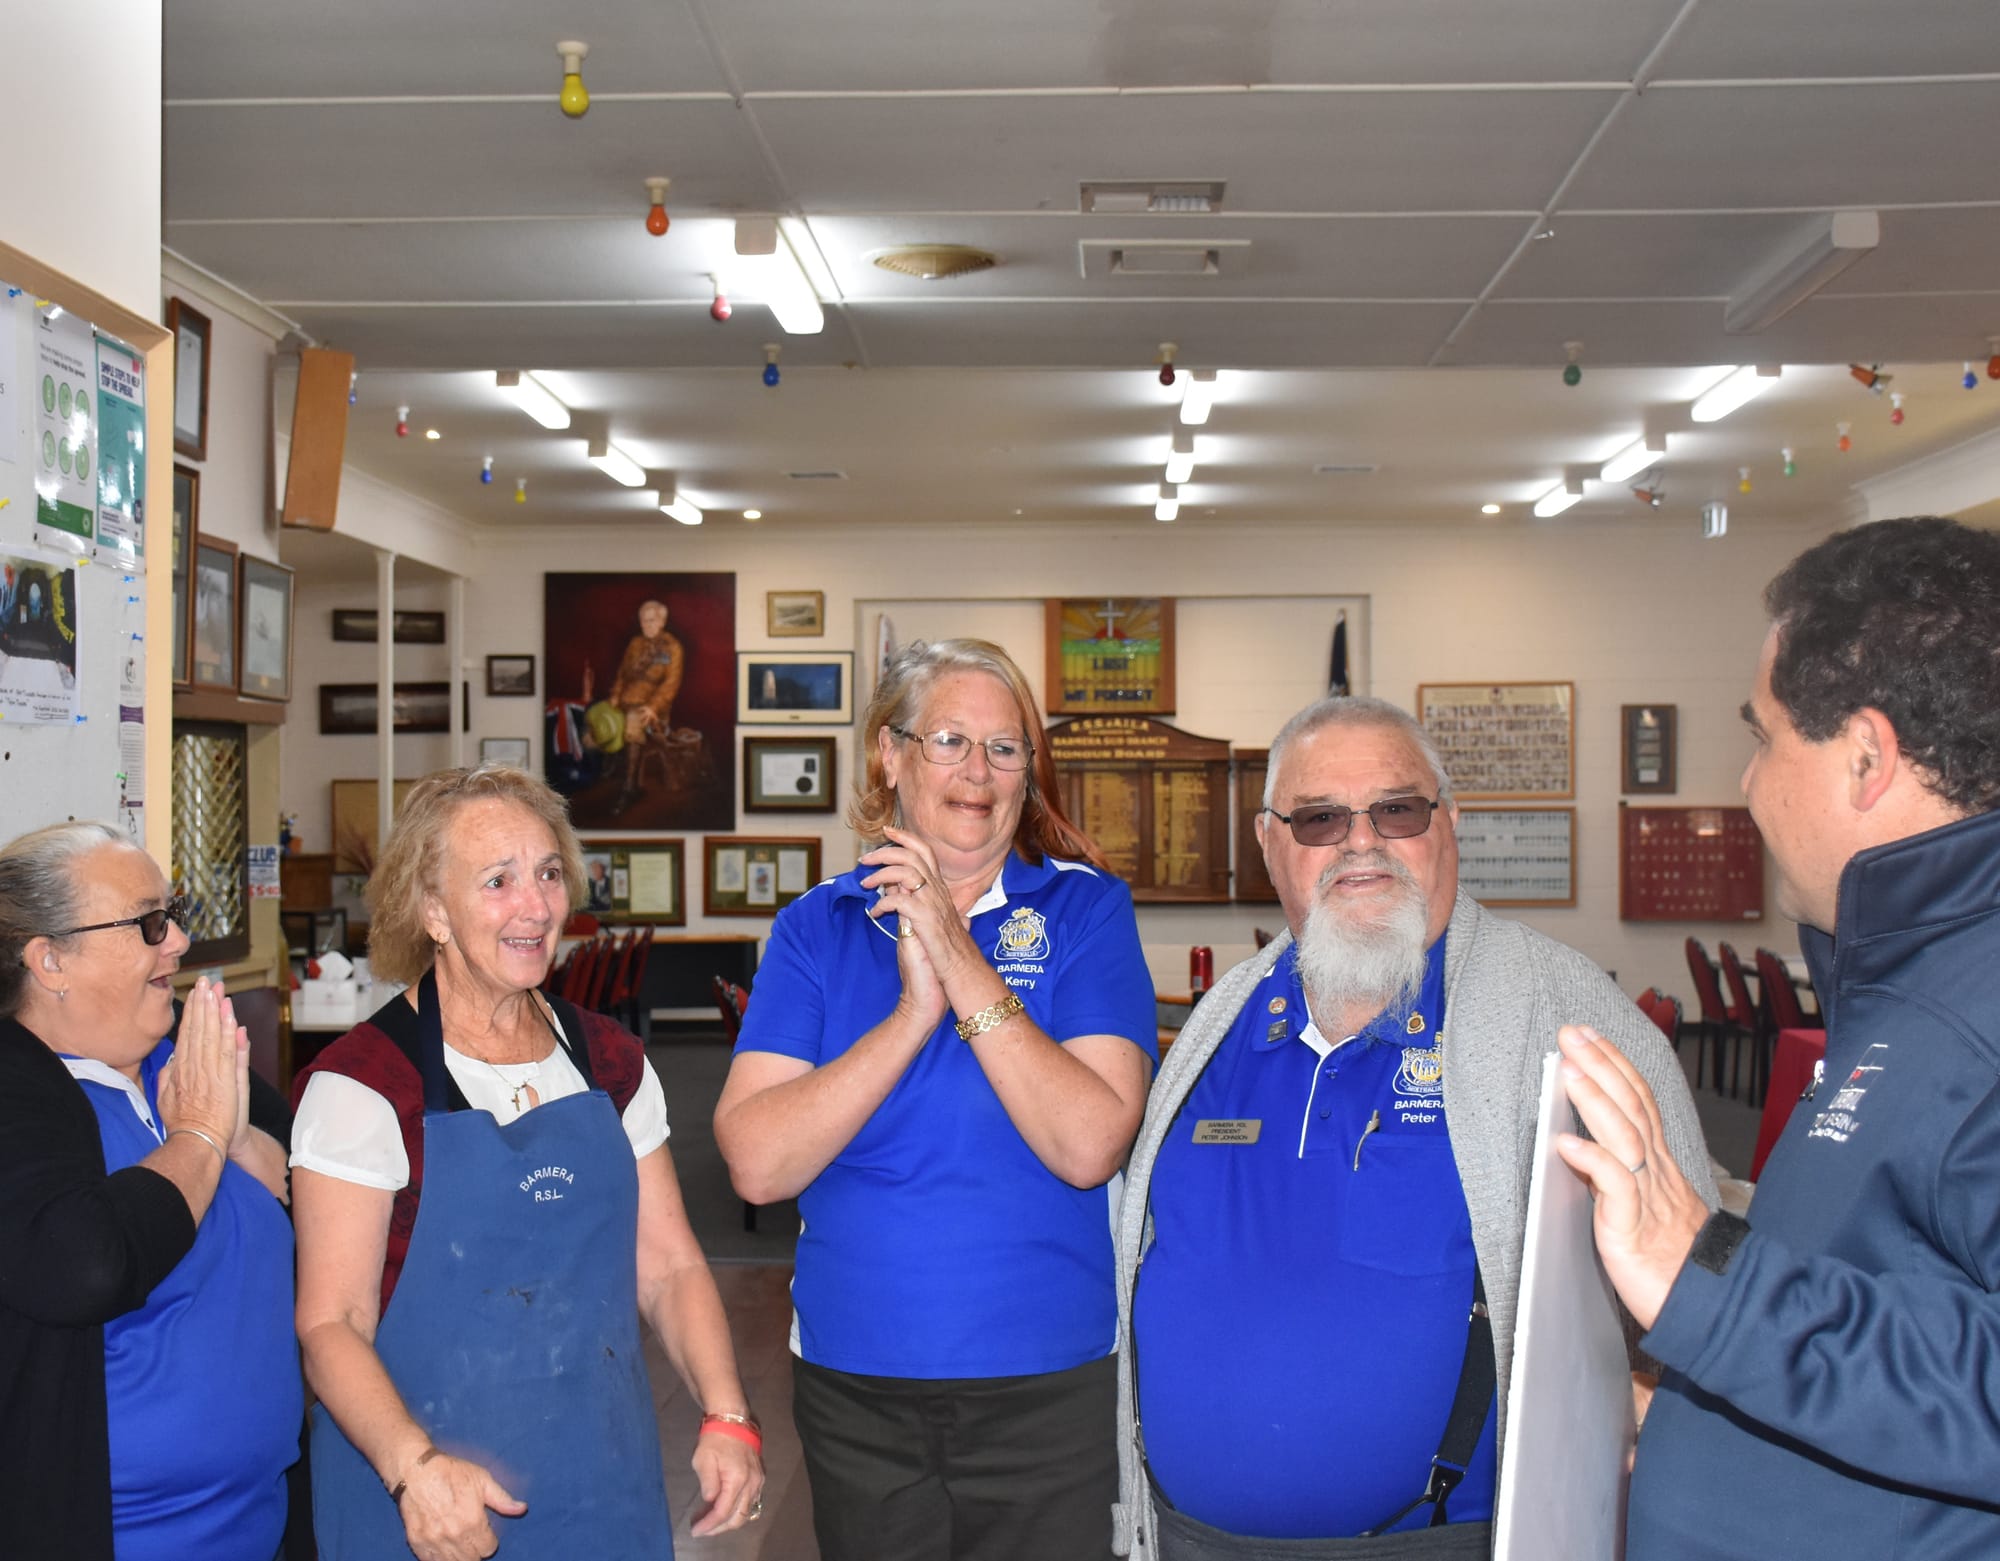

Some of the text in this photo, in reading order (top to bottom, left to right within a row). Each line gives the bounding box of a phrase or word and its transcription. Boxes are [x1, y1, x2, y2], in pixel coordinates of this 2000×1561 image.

[1093, 657, 1128, 670] LEST
[1064, 689, 1152, 702] WE FORGET
[1053, 736, 1101, 746] BARMERA
[1114, 748, 1165, 759] BOARD
[997, 963, 1044, 974] BARMERA
[1005, 976, 1035, 989] Kerry
[1401, 1112, 1437, 1123] Peter
[520, 1166, 574, 1192] BARMERA
